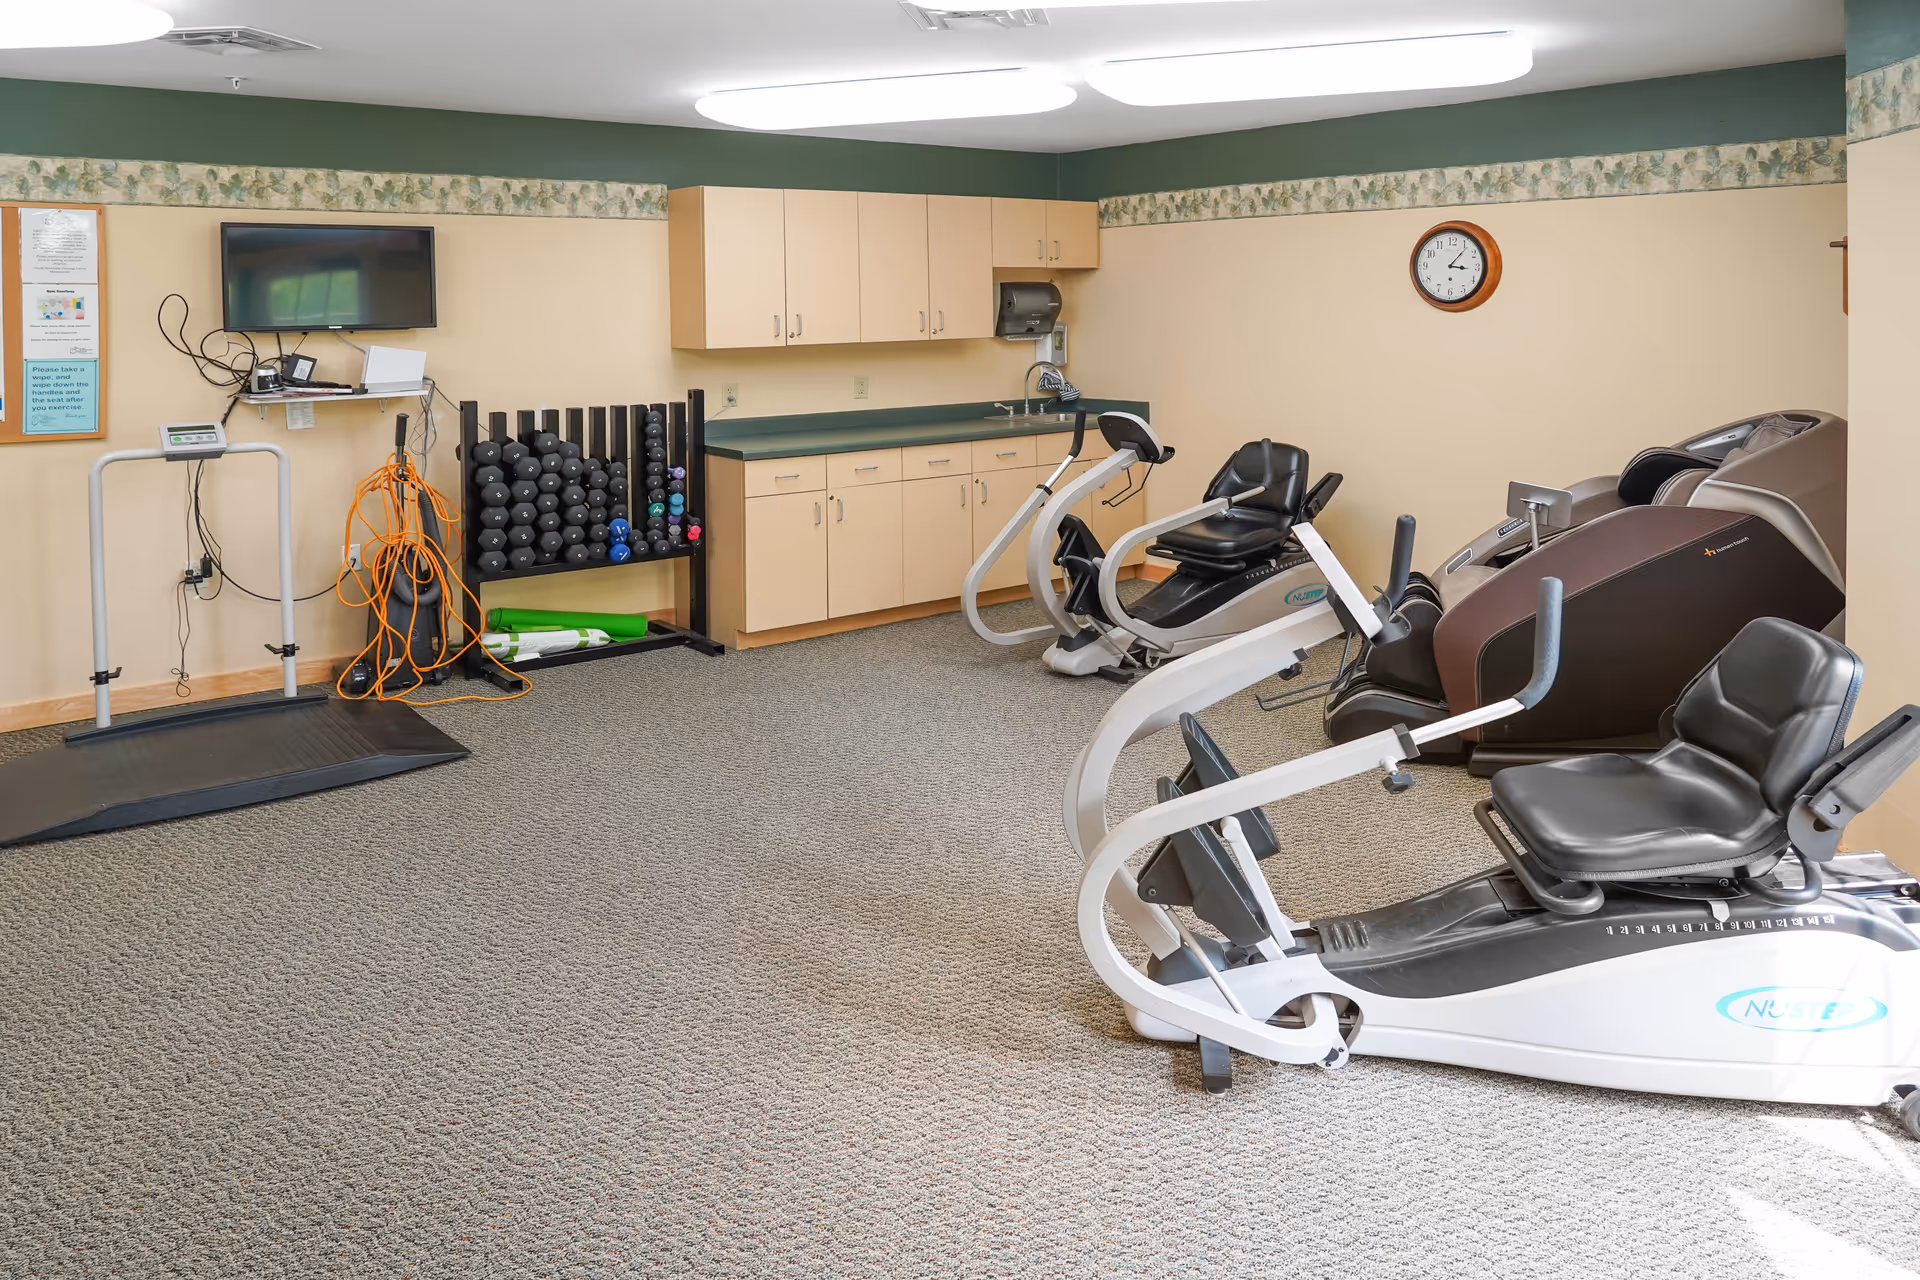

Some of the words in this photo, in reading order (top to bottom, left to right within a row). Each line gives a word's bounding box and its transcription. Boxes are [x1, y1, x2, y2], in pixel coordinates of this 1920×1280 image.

[1436, 241, 1443, 249] 11
[1448, 237, 1457, 246] 12
[1463, 240, 1466, 248] 1
[1427, 250, 1435, 258] 10
[1472, 250, 1476, 258] 2
[1423, 262, 1428, 270] 9
[1475, 263, 1480, 272] 3
[1426, 275, 1431, 283] 8
[1470, 275, 1476, 284] 4
[1437, 284, 1441, 293] 7
[1448, 288, 1453, 296] 6
[1460, 285, 1466, 293] 5
